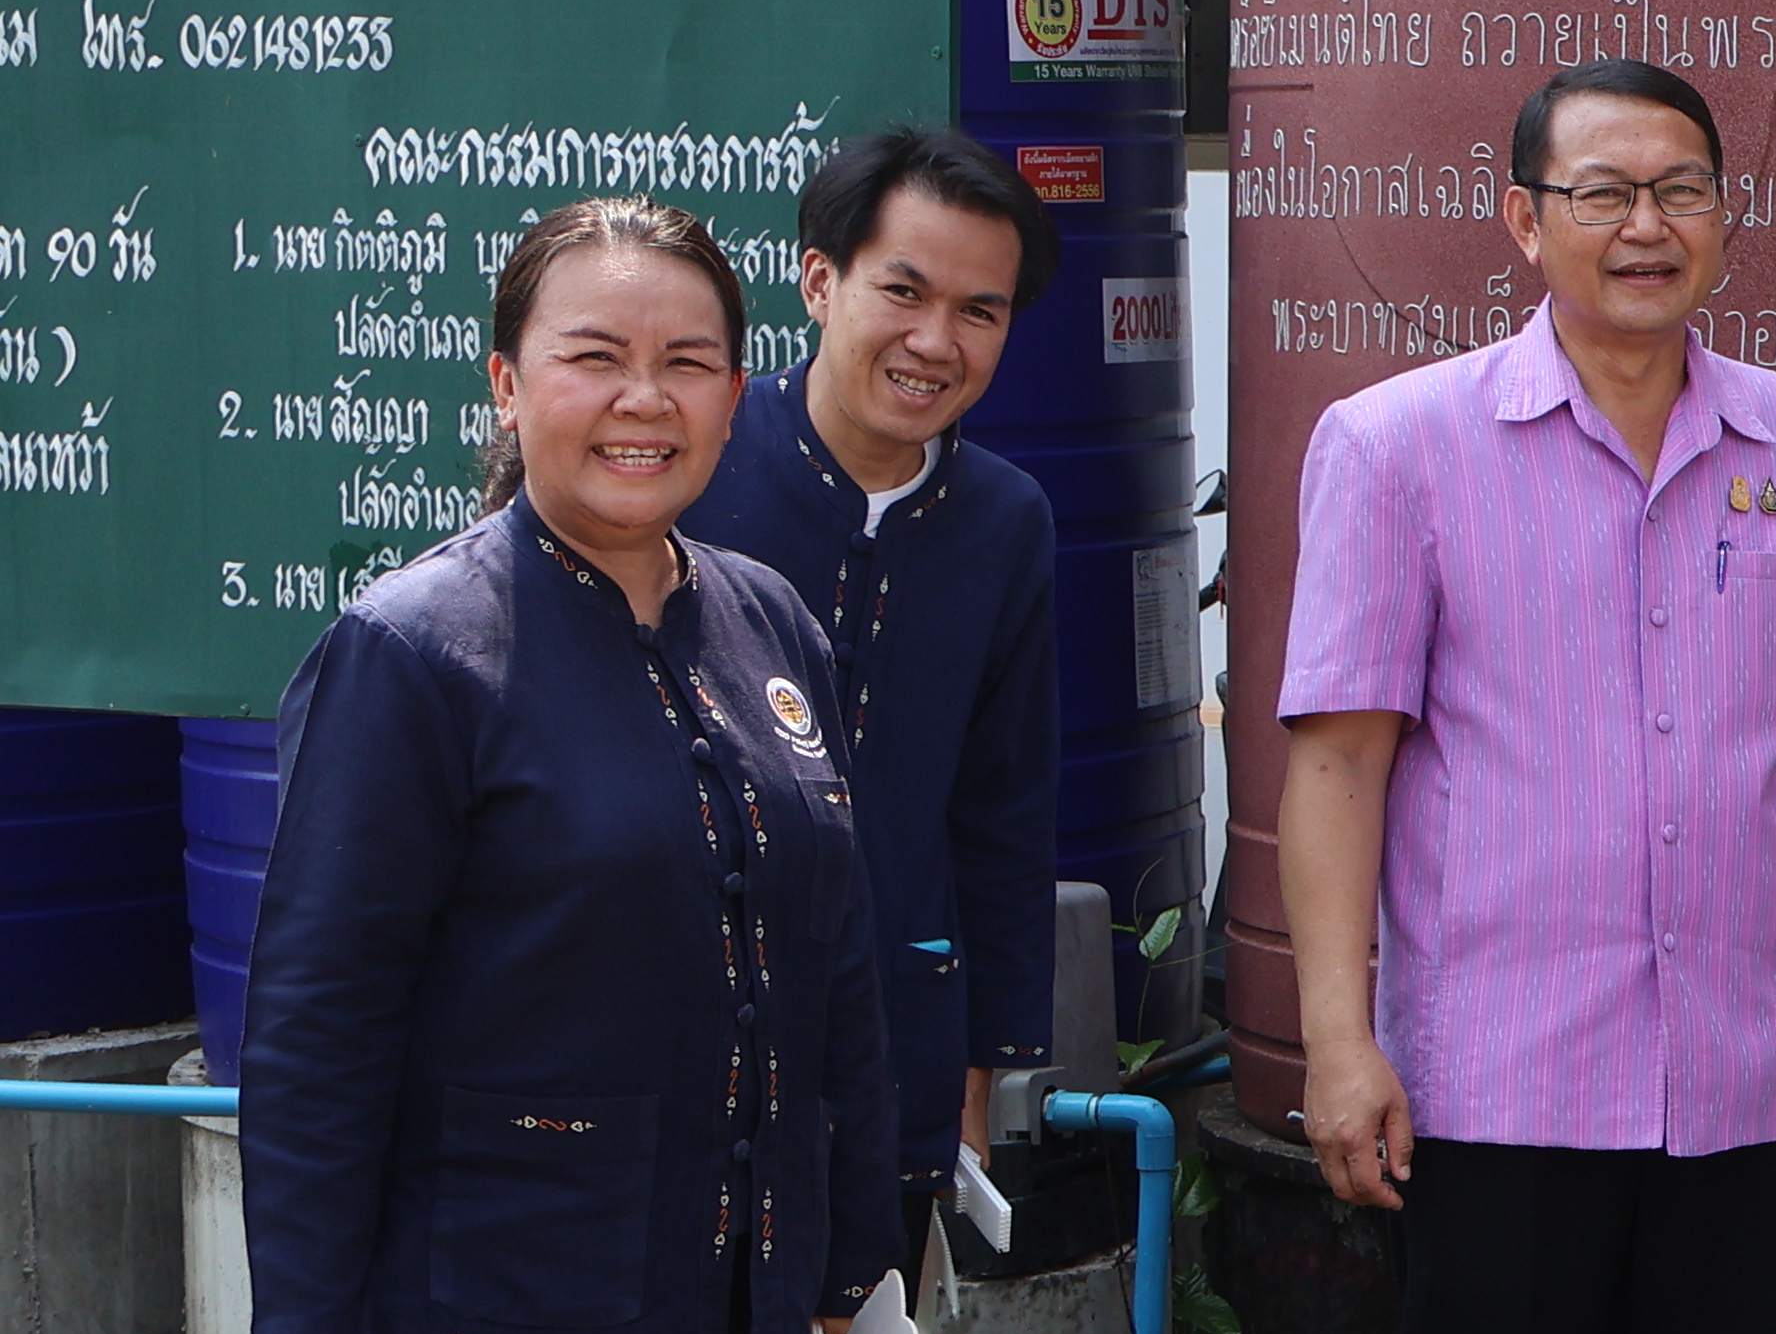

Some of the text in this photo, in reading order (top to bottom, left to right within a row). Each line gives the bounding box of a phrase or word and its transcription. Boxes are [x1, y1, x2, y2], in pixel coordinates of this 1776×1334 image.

[180, 13, 394, 74] 0621481233
[1034, 21, 1067, 36] Years
[1034, 64, 1050, 79] 15
[1051, 64, 1083, 79] Years
[233, 218, 260, 272] 1.
[1111, 295, 1162, 341] 2000
[218, 389, 259, 440] 2.
[220, 561, 260, 608] 3.
